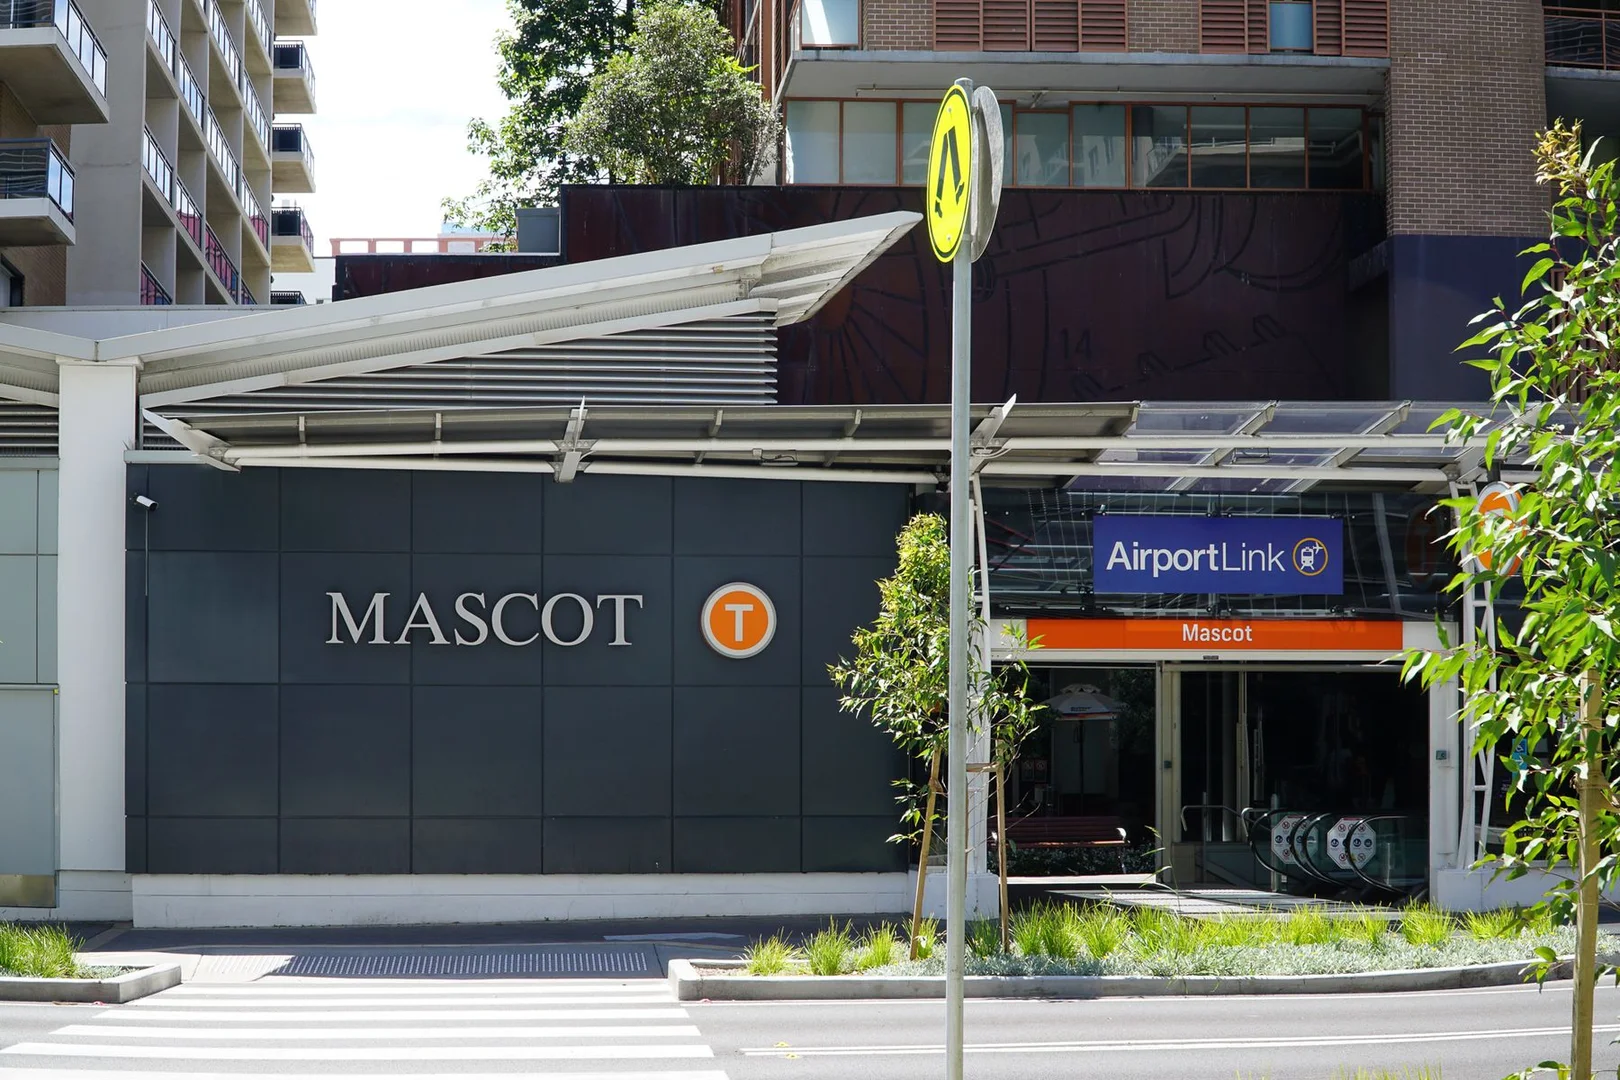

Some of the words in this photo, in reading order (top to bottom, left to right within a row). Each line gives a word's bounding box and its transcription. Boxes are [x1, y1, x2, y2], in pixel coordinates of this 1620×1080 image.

[1106, 541, 1286, 578] AirportLink
[325, 592, 643, 646] MASCOT
[724, 603, 754, 642] T
[1182, 623, 1253, 642] Mascot
